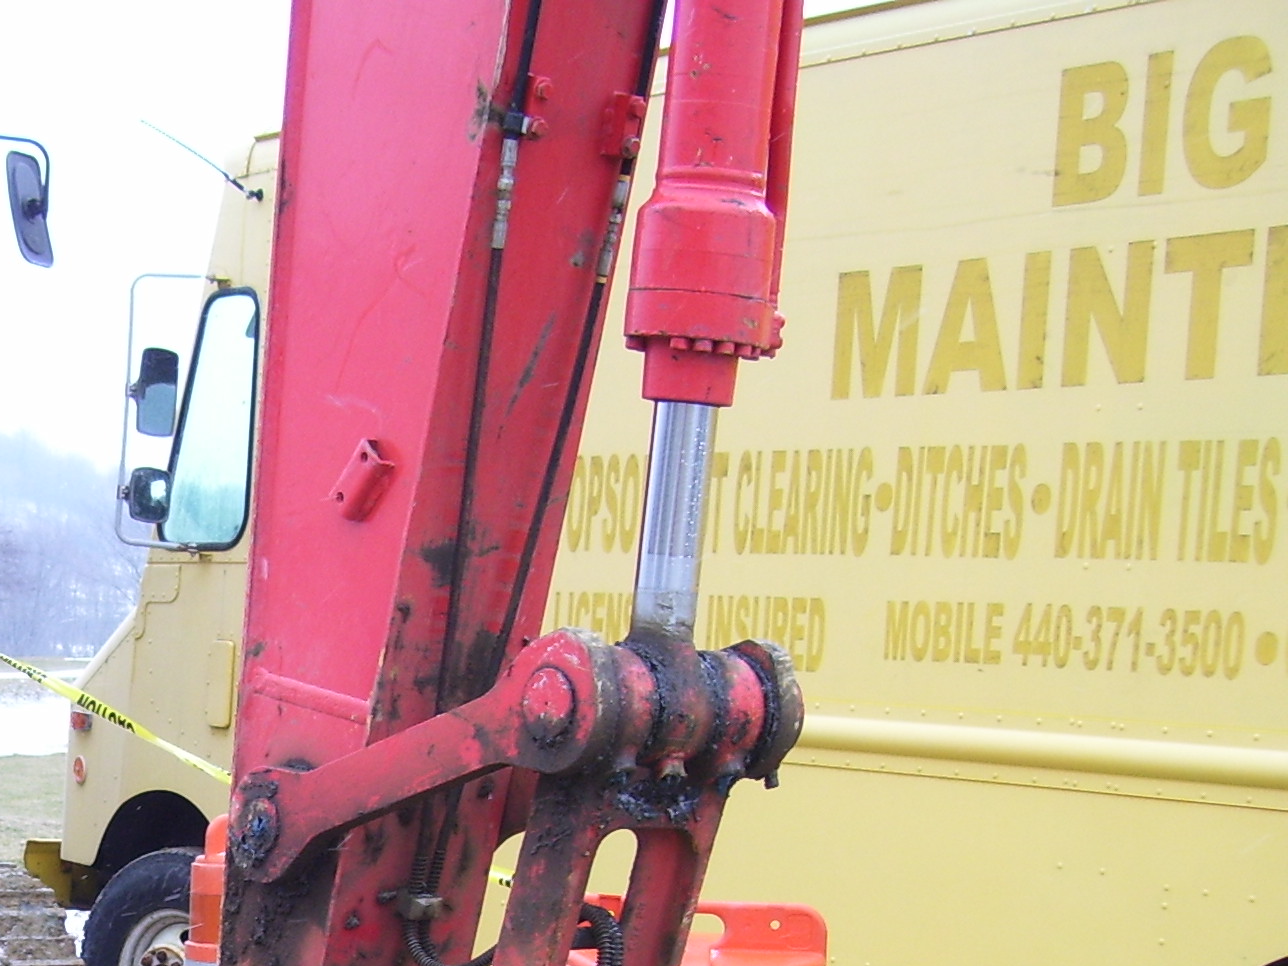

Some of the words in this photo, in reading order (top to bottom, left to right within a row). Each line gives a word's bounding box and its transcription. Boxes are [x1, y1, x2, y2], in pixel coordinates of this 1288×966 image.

[1052, 35, 1273, 207] BIG
[567, 453, 648, 553] OPSO
[733, 447, 873, 557] CLEARING
[890, 443, 1027, 560] DITCHES
[1054, 441, 1167, 561] DRAIN
[1177, 437, 1281, 565] TILES
[705, 594, 826, 672] INSURED
[884, 600, 1004, 665] MOBILE
[1013, 602, 1245, 681] 440-371-3500
